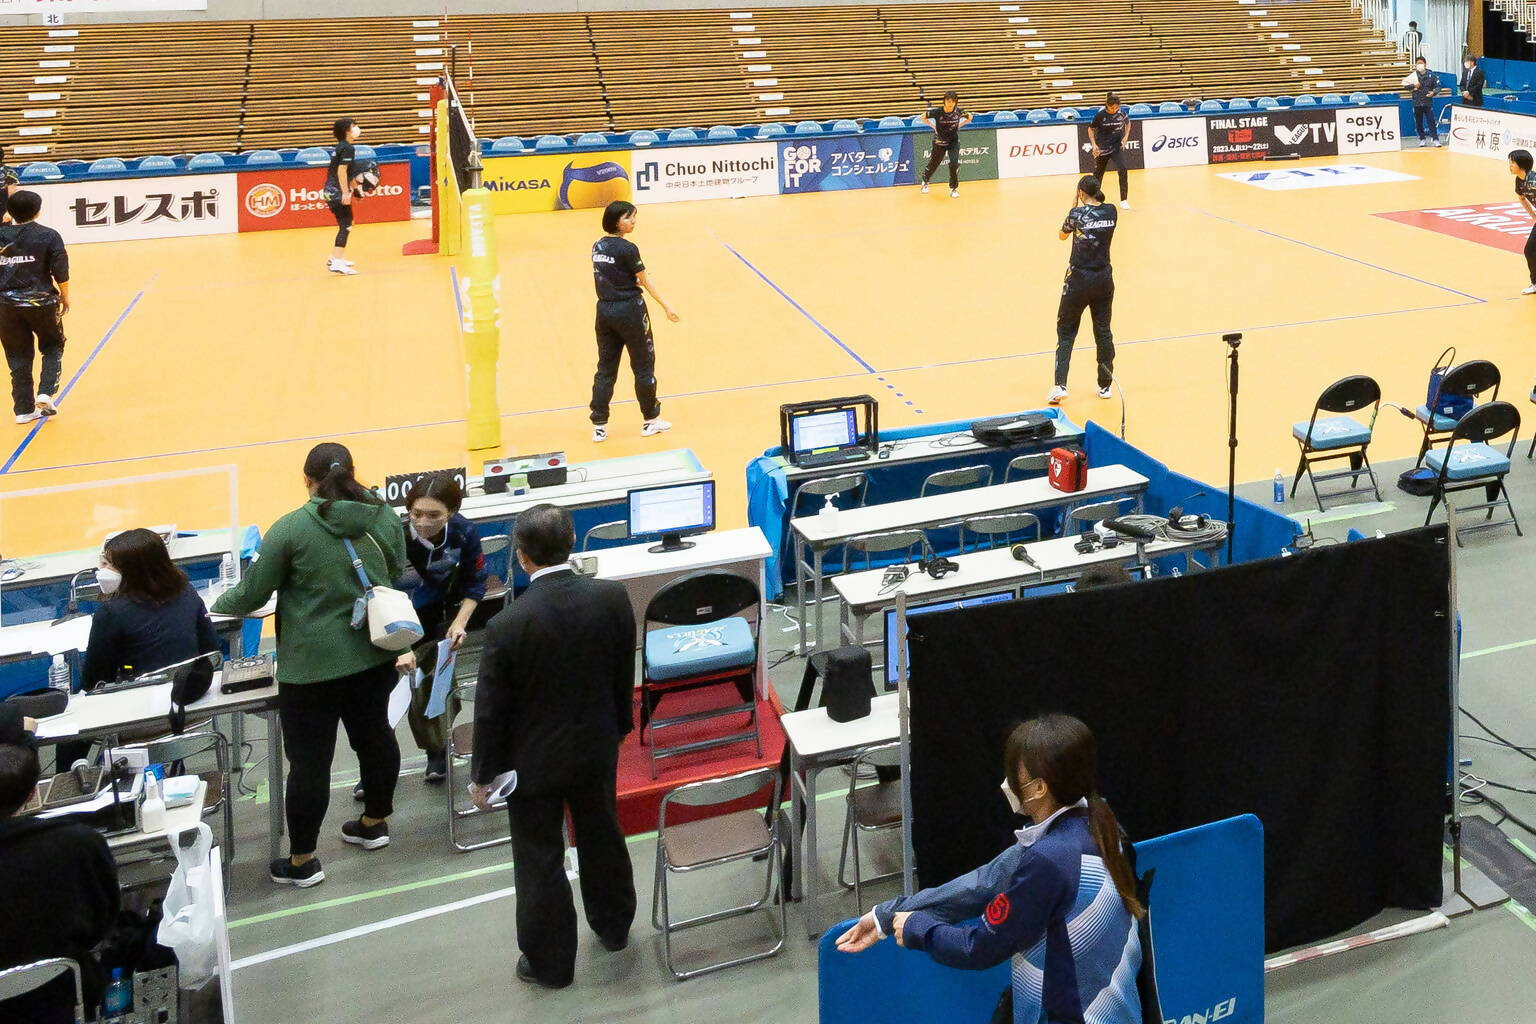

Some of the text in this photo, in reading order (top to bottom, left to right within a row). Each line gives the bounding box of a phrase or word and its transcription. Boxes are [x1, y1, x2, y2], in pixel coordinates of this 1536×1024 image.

[47, 14, 59, 24] 北
[1211, 116, 1268, 130] FINAL STAGE
[1346, 115, 1383, 129] easy
[1168, 136, 1199, 149] asics
[1476, 129, 1501, 151] 林原
[1009, 141, 1068, 158] DENSO
[831, 152, 877, 165] アバター
[665, 156, 775, 177] Chuo Nittochi
[784, 160, 822, 174] FOR
[831, 162, 909, 177] コンシェルジュ
[665, 177, 759, 190] 中央日本土地建物グループ
[784, 173, 803, 188] IT
[252, 194, 281, 207] HM
[69, 187, 220, 229] セレスポ
